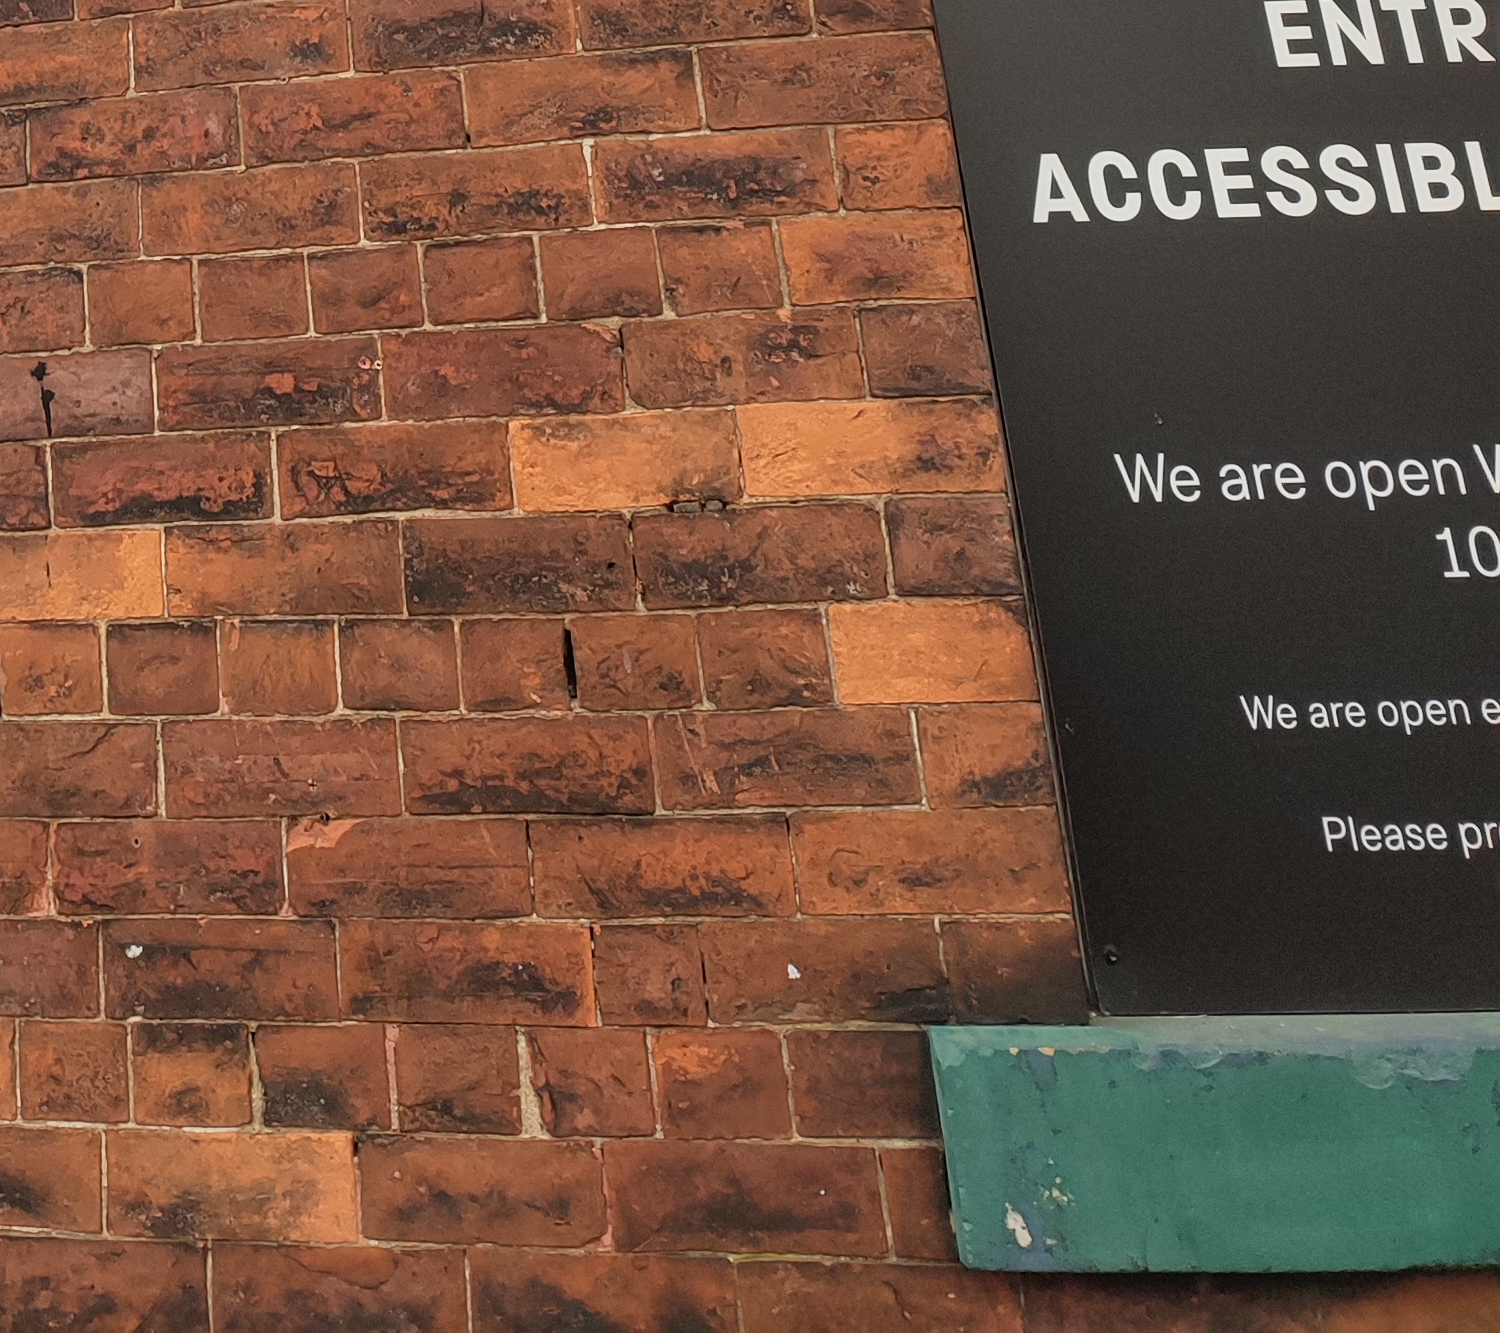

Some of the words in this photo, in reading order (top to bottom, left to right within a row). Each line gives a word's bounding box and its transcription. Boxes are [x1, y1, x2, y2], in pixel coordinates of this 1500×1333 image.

[1032, 140, 1500, 224] ACCESSIBL
[1113, 452, 1202, 503] We
[1218, 462, 1307, 501] are
[1324, 457, 1467, 511] open
[1434, 524, 1500, 579] 10
[1239, 694, 1298, 730] We
[1308, 701, 1367, 729] are
[1377, 699, 1471, 736] open
[1321, 815, 1448, 853] Please
